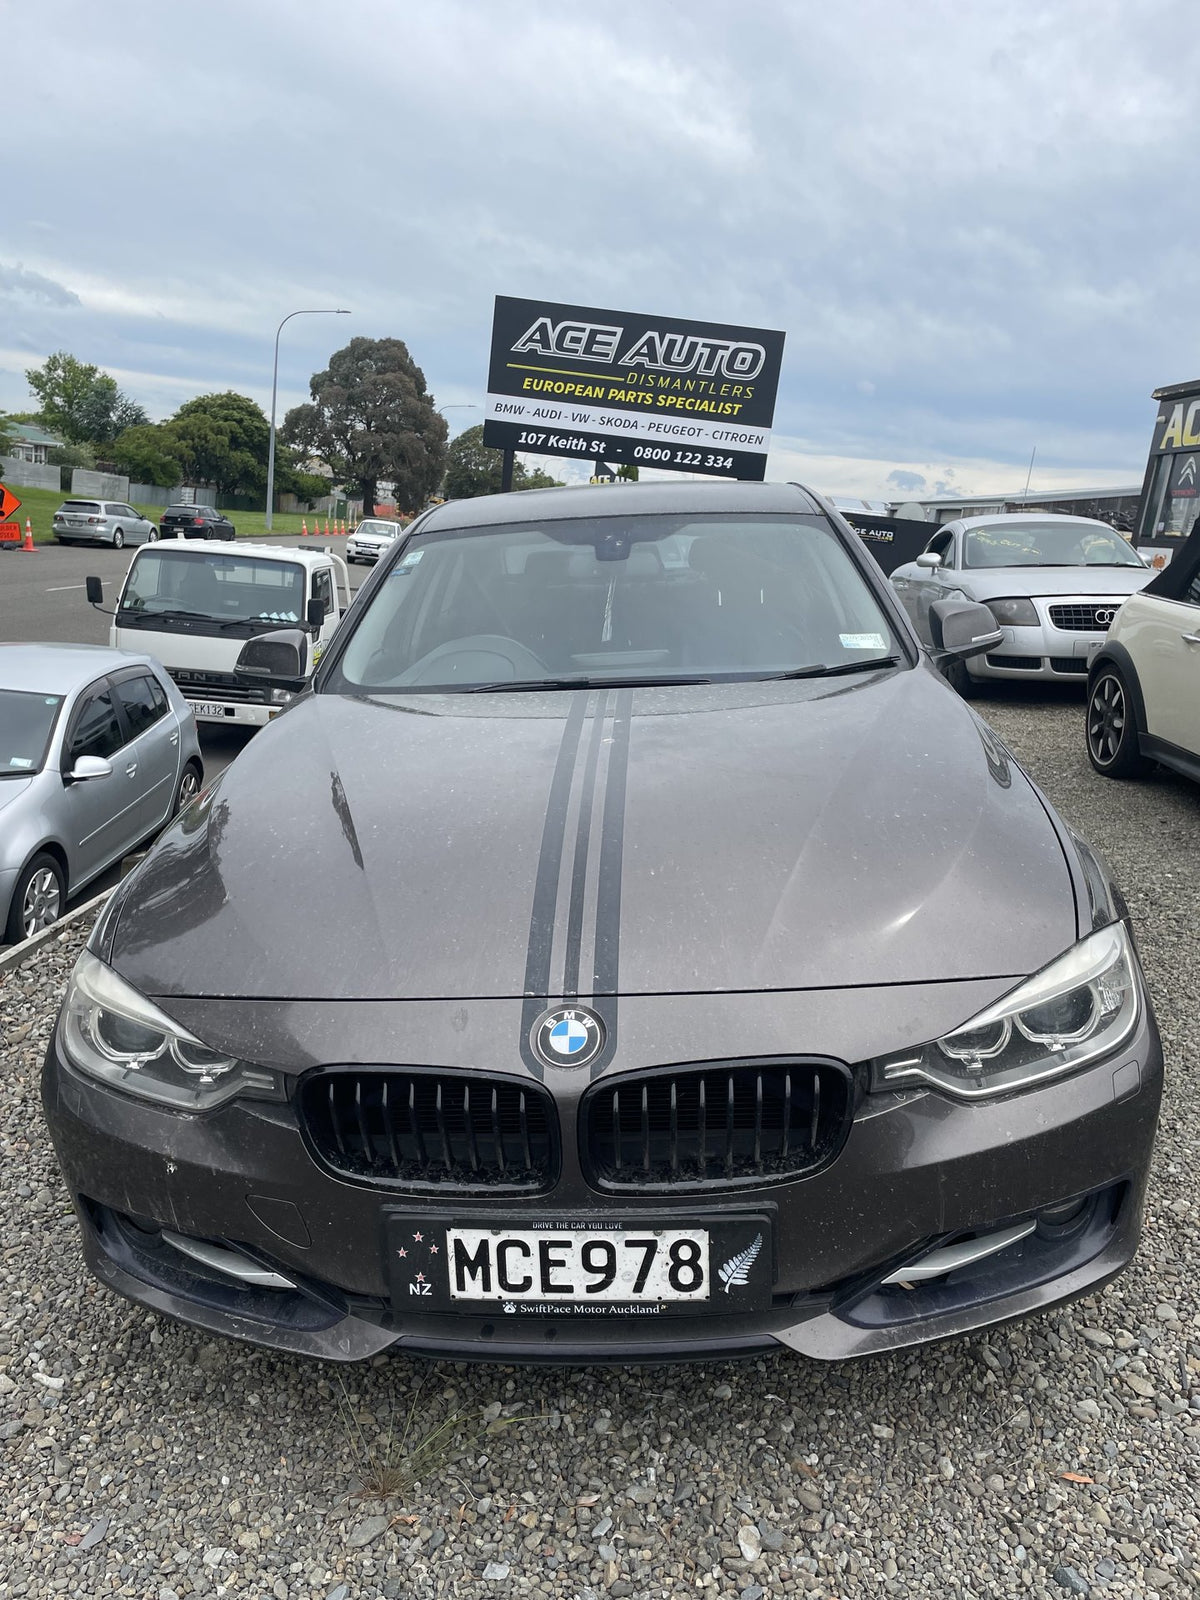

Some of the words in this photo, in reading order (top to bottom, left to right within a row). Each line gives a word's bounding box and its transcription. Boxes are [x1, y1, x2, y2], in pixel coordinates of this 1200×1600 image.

[510, 317, 624, 363] ACE
[618, 330, 766, 380] AUTO
[522, 377, 605, 399] EUROPEAN
[607, 388, 654, 405] PARTS
[656, 394, 743, 416] SPECIALIST
[626, 372, 755, 399] DISMANTLERS
[494, 402, 525, 415] BMW
[532, 407, 562, 420] AUDI
[571, 412, 591, 424] VW
[598, 415, 639, 430] SKODA
[647, 422, 704, 438] PEUGEOT
[712, 430, 764, 445] CITROEN
[518, 431, 546, 446] 107
[547, 434, 588, 451] Keith
[589, 440, 606, 454] St
[633, 446, 671, 461] 0800
[673, 451, 702, 466] 122
[704, 455, 734, 469] 334
[854, 527, 867, 535] CE
[868, 529, 894, 538] AUTO
[545, 1011, 595, 1029] BMW
[532, 1221, 554, 1229] DRIVE
[556, 1221, 569, 1229] THE
[571, 1221, 586, 1229] CAR
[588, 1222, 603, 1230] YOU
[605, 1222, 623, 1230] LOVE
[453, 1238, 704, 1294] MCE978
[409, 1283, 433, 1296] NZ
[520, 1303, 571, 1314] SwiftPace
[574, 1304, 607, 1314] Motor
[609, 1304, 660, 1314] Auckland
